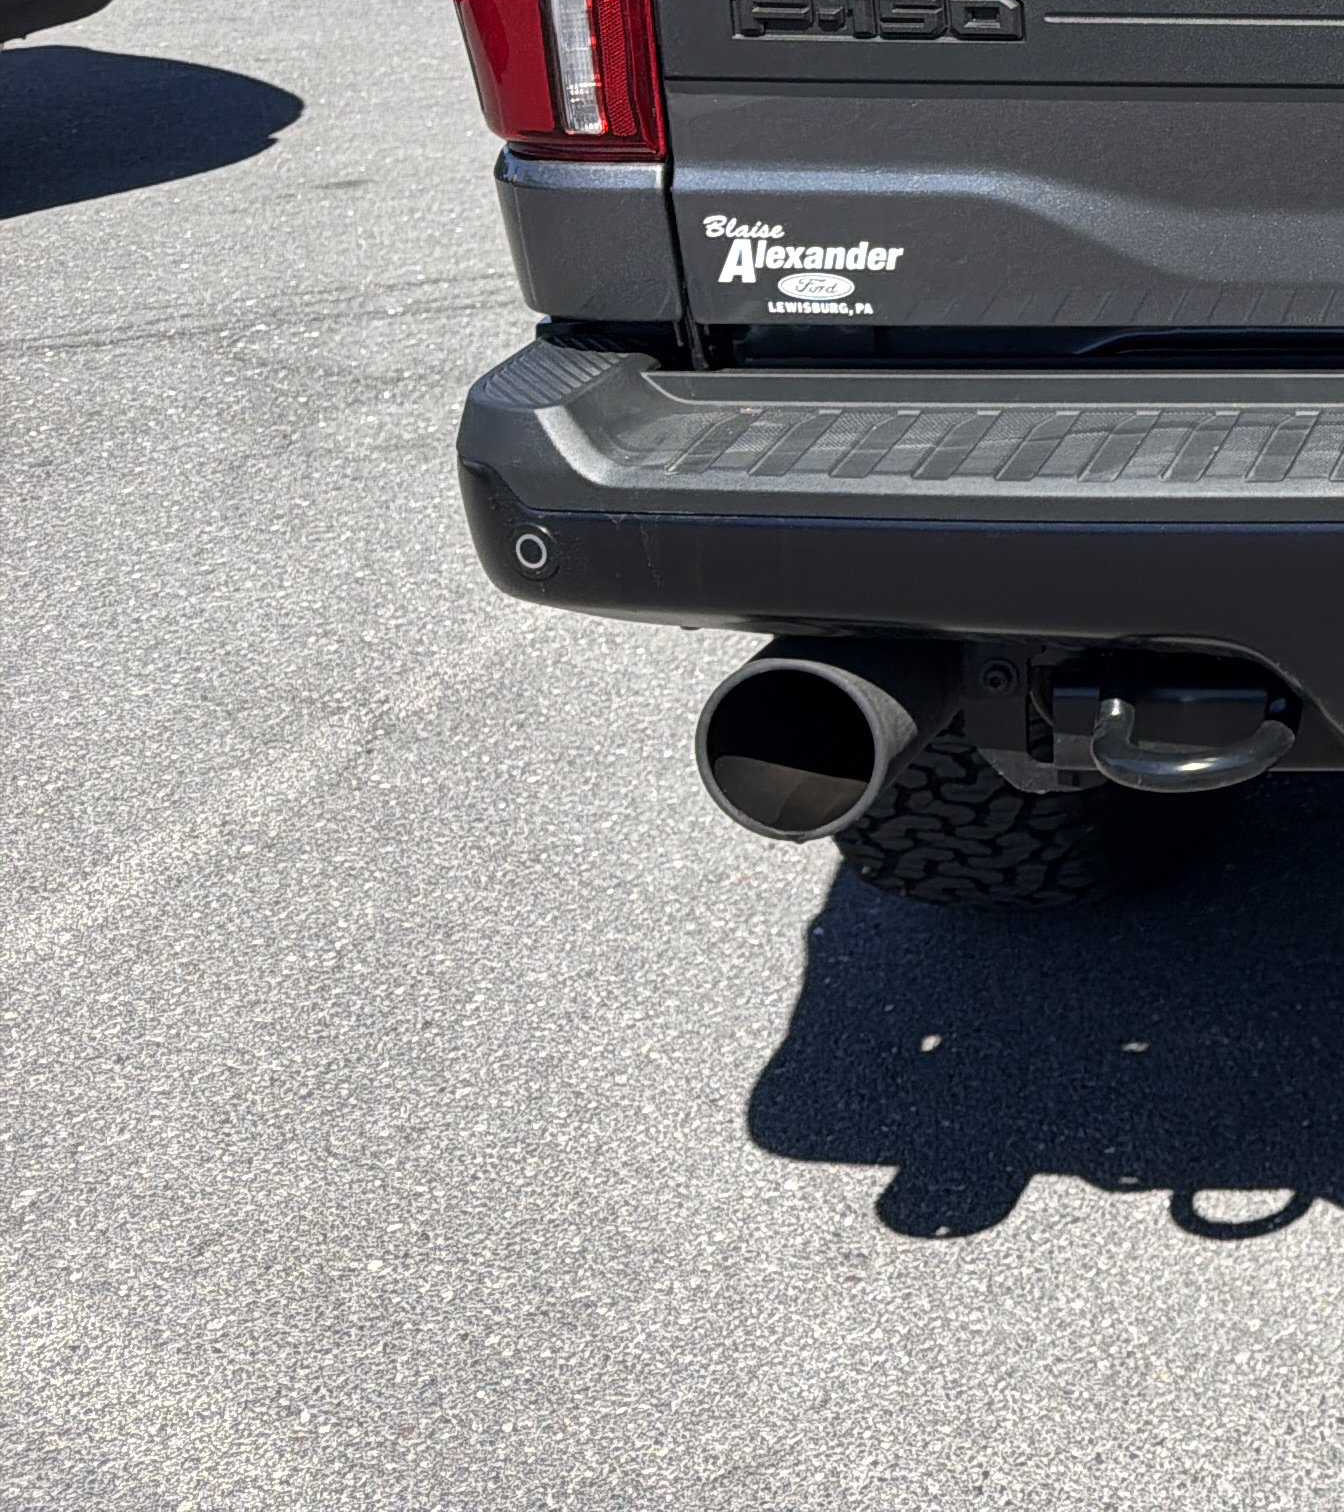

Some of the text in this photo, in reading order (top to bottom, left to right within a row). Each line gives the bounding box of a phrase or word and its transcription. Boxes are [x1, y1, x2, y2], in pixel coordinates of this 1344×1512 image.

[703, 215, 785, 238] Blaise
[718, 238, 904, 283] Alexander
[795, 278, 838, 293] Ford
